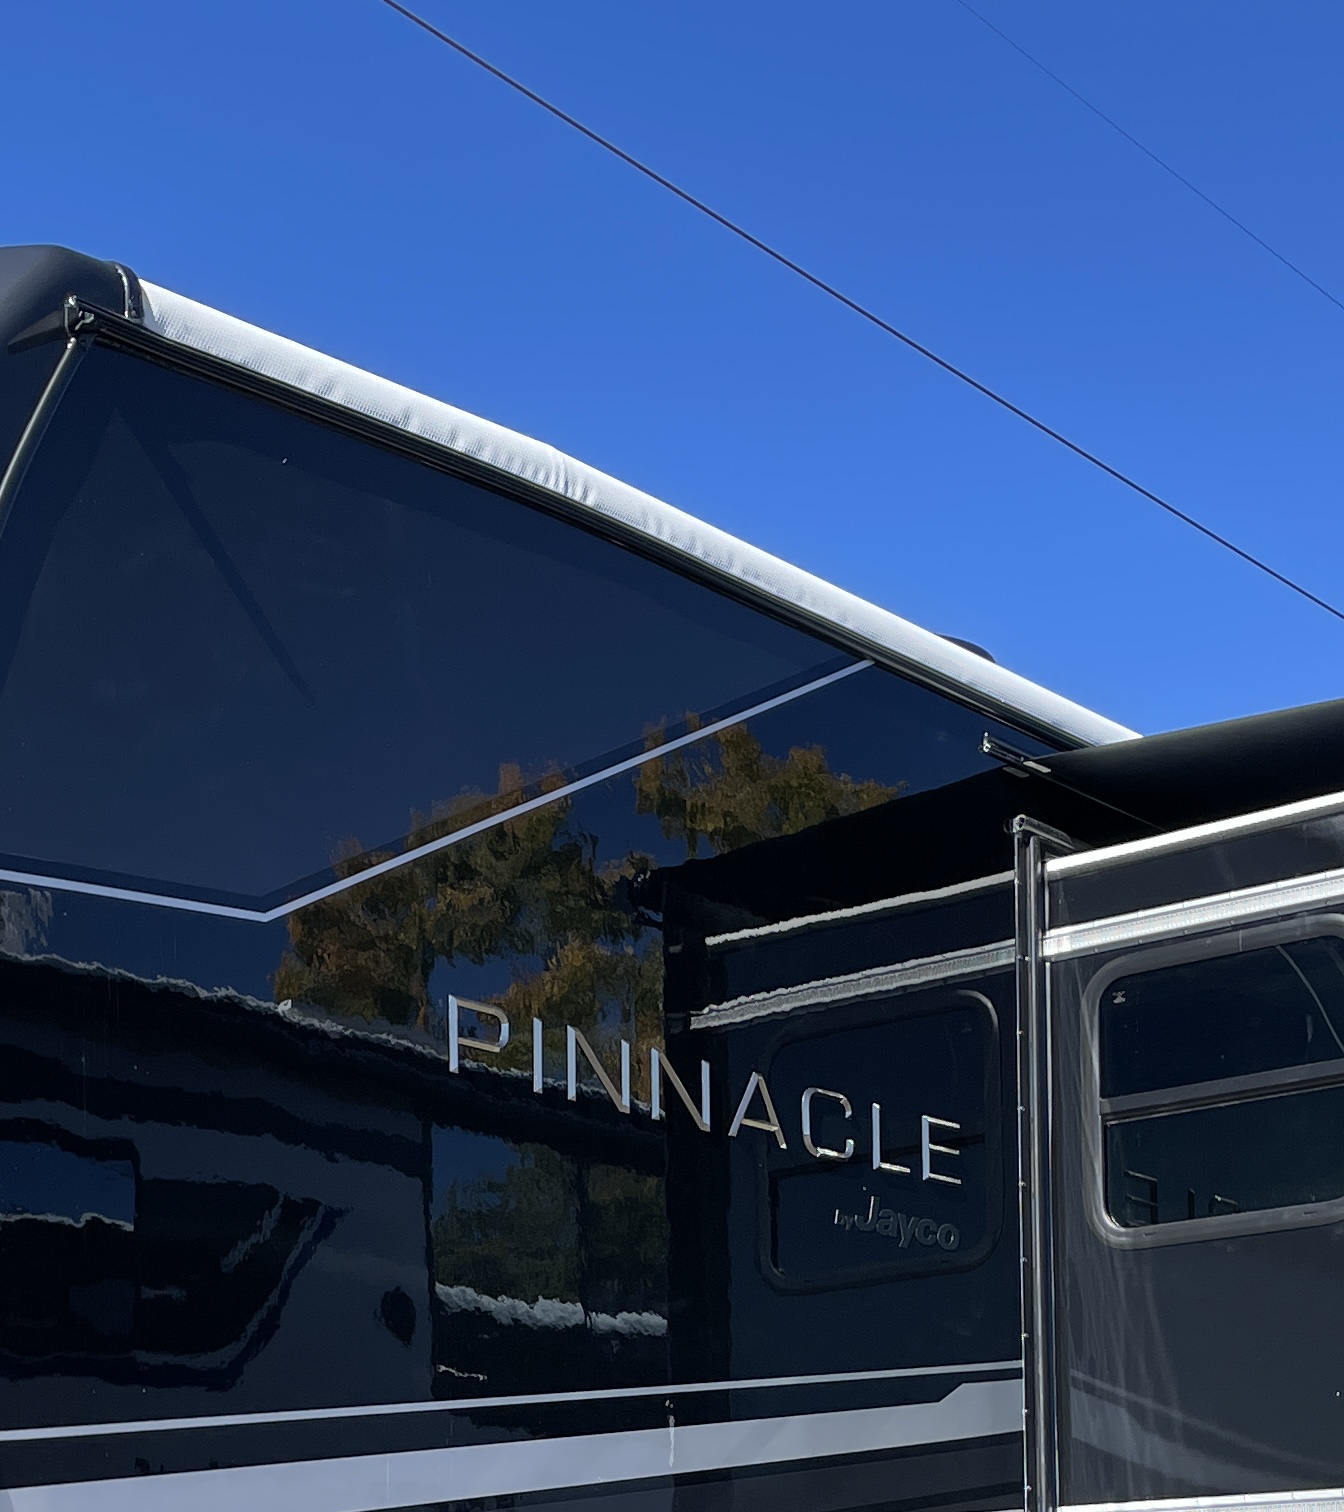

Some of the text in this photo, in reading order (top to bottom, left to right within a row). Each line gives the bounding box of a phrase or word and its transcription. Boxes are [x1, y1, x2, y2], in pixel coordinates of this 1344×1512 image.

[447, 993, 962, 1185] PINNACLE
[834, 1194, 960, 1251] by Jayco
